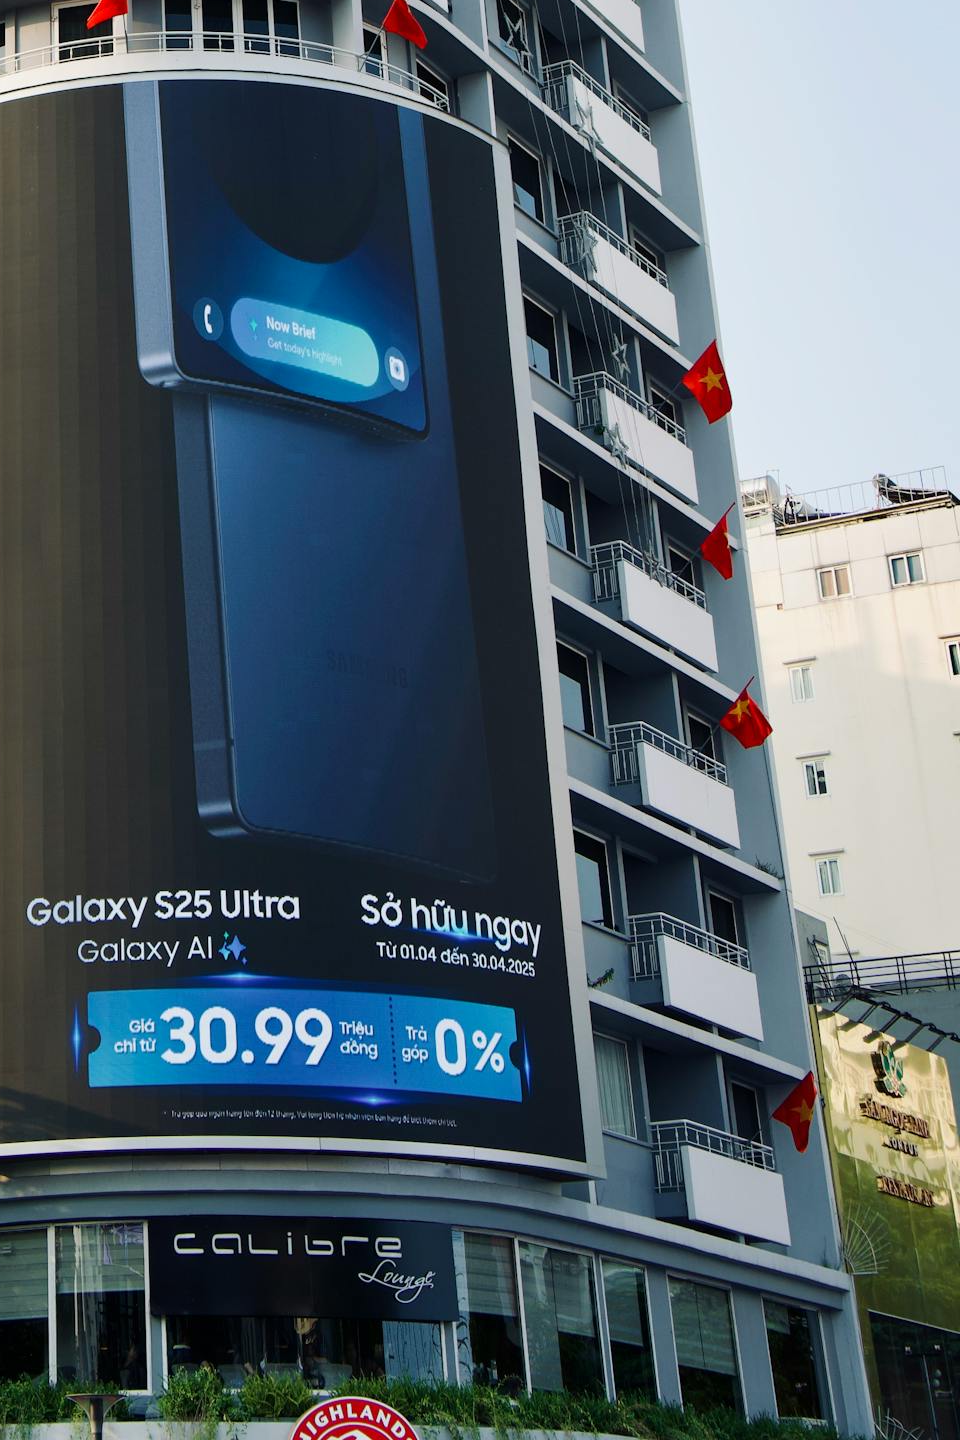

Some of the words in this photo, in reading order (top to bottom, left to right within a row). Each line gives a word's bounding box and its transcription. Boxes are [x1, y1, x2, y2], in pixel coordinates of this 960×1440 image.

[266, 315, 290, 334] Now
[292, 321, 316, 340] Brief
[267, 337, 282, 350] Get
[284, 342, 311, 358] today's
[26, 894, 148, 928] Galaxy
[154, 889, 212, 920] S25
[220, 888, 301, 920] Ultra
[360, 891, 403, 928] Sở
[410, 897, 469, 937] hữu
[474, 912, 541, 958] ngay
[77, 938, 180, 968] Galaxy
[187, 935, 213, 960] AI
[376, 940, 398, 959] Từ
[400, 944, 437, 962] 01.04
[440, 946, 470, 967] đến
[472, 952, 536, 978] 30.04.2025
[128, 1018, 156, 1034] Giá
[159, 1005, 333, 1065] 30.99
[339, 1019, 374, 1040] Triệu
[140, 1038, 157, 1053] từ
[340, 1037, 378, 1060] đồng
[401, 1044, 429, 1063] góp
[434, 1017, 505, 1076] 0%
[357, 1258, 436, 1304] Lounge
[299, 1403, 413, 1440] IGHLAND
